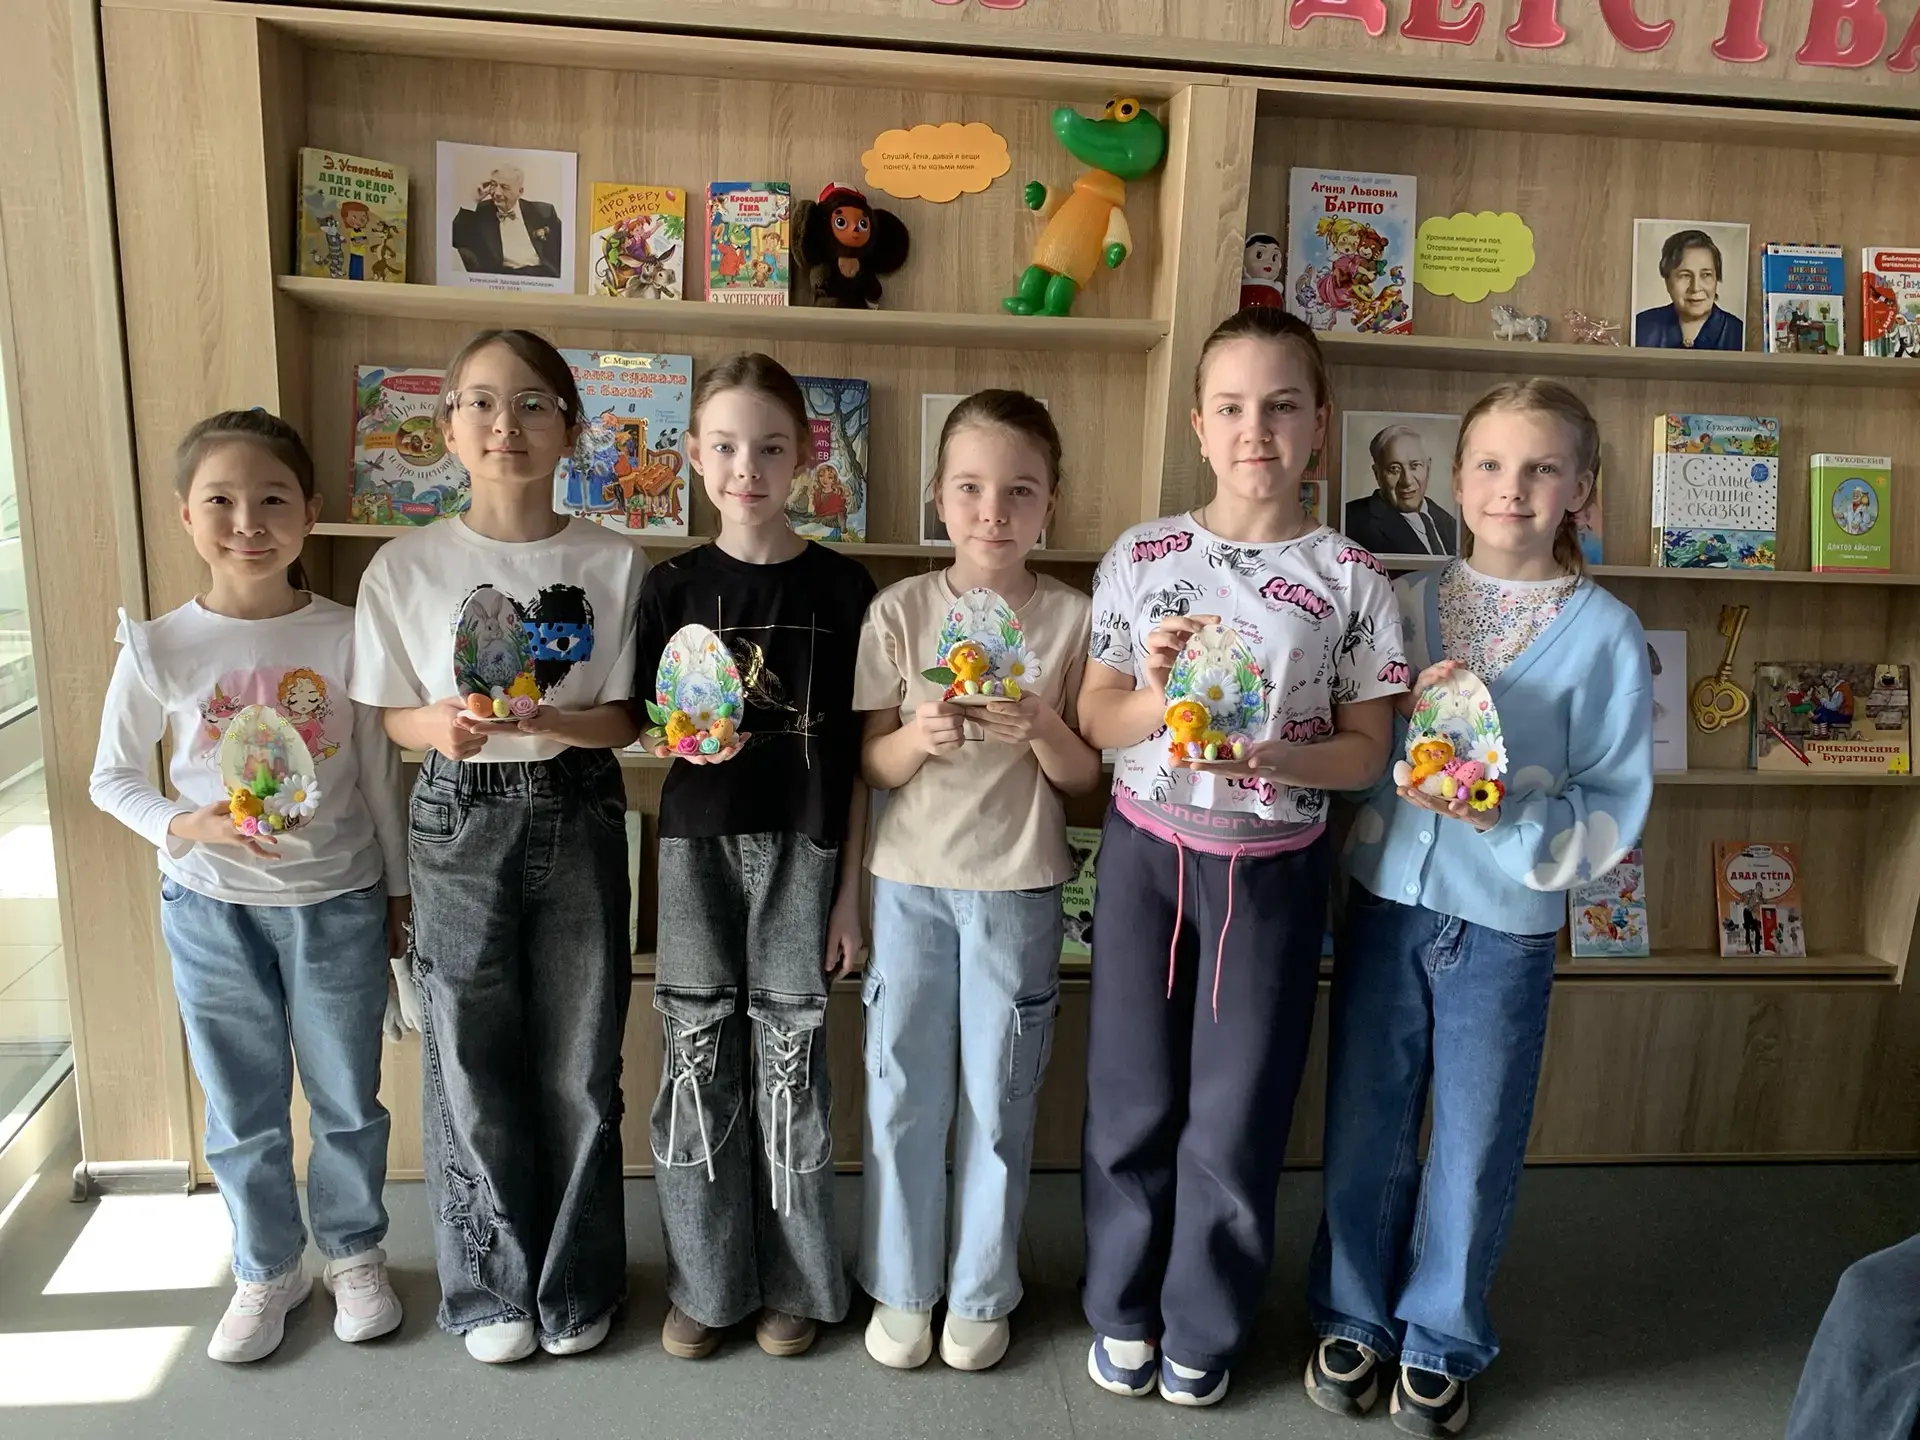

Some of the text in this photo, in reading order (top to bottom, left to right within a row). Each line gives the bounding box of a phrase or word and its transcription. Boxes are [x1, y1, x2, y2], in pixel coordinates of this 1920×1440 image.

[881, 152, 911, 160] Слушай,
[913, 152, 931, 160] Гена,
[932, 152, 954, 160] давай
[318, 172, 352, 187] ДЯДЯ
[353, 191, 361, 201] И
[365, 193, 388, 205] КОТ
[598, 191, 661, 215] ПРО ВЕРУ
[614, 202, 661, 220] АНФИСУ
[723, 291, 785, 305] УСПЕНСКИЙ
[613, 357, 647, 367] Маршак
[1834, 455, 1884, 465] ЧУКОВСКИЙ
[1683, 457, 1754, 489] Самые
[1684, 487, 1754, 503] лучшие
[1687, 502, 1751, 520] сказки
[1259, 576, 1335, 620] FUNNY
[1807, 743, 1900, 754] Приключения
[1823, 753, 1886, 764] Буратино
[1730, 872, 1758, 880] ДЯДЯ
[1063, 886, 1084, 895] МКА
[1061, 896, 1091, 906] ОРОКА
